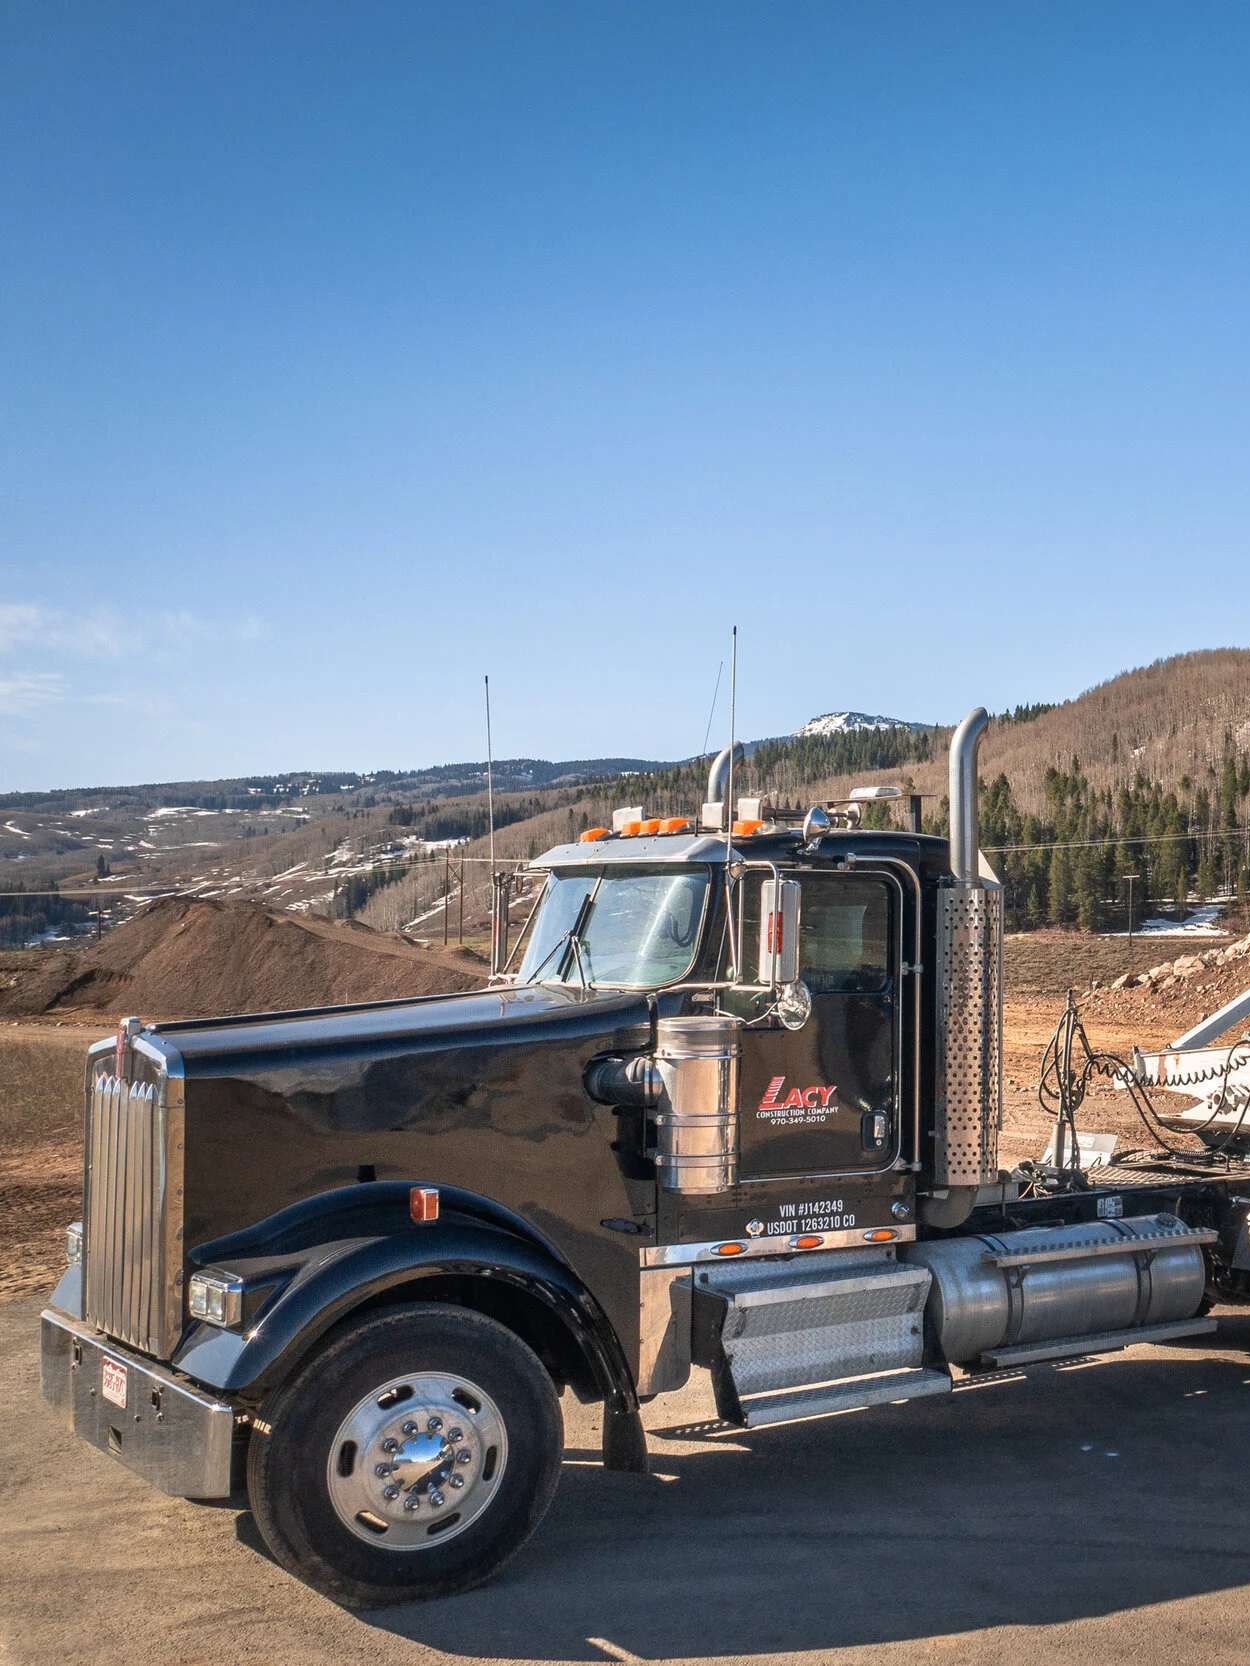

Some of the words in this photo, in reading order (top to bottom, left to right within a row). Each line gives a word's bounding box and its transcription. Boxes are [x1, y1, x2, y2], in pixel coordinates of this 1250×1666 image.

[759, 1076, 837, 1110] LACY
[756, 1109, 805, 1119] CONSTRUCTION
[807, 1106, 839, 1115] COMPANY
[771, 1115, 826, 1125] 970-349-5010
[779, 1204, 796, 1218] VIN
[798, 1200, 843, 1216] #J142349
[767, 1220, 798, 1235] USDOT
[801, 1216, 840, 1232] 1263210
[843, 1214, 855, 1227] CO
